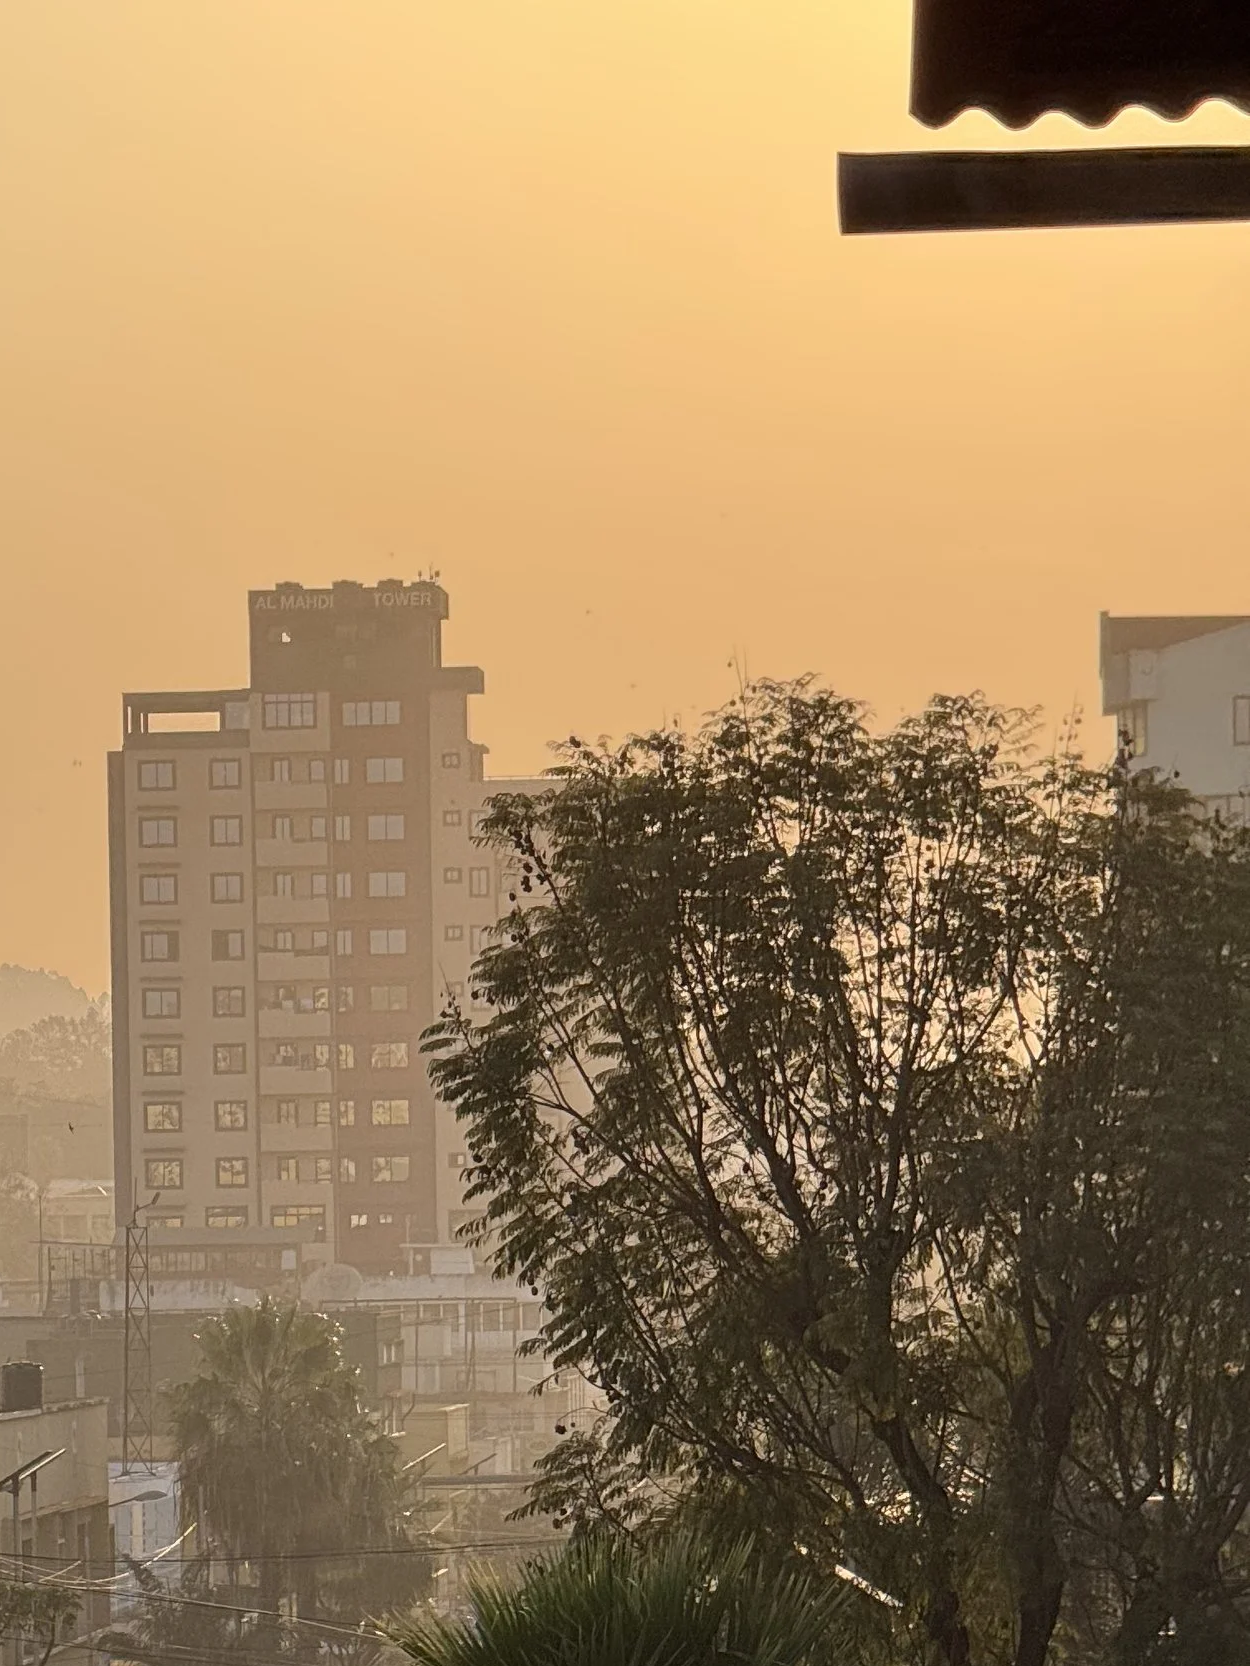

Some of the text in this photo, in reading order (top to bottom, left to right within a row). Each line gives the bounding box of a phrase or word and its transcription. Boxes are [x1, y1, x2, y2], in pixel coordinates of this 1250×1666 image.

[255, 591, 432, 610] AL MAHDI TOWER
